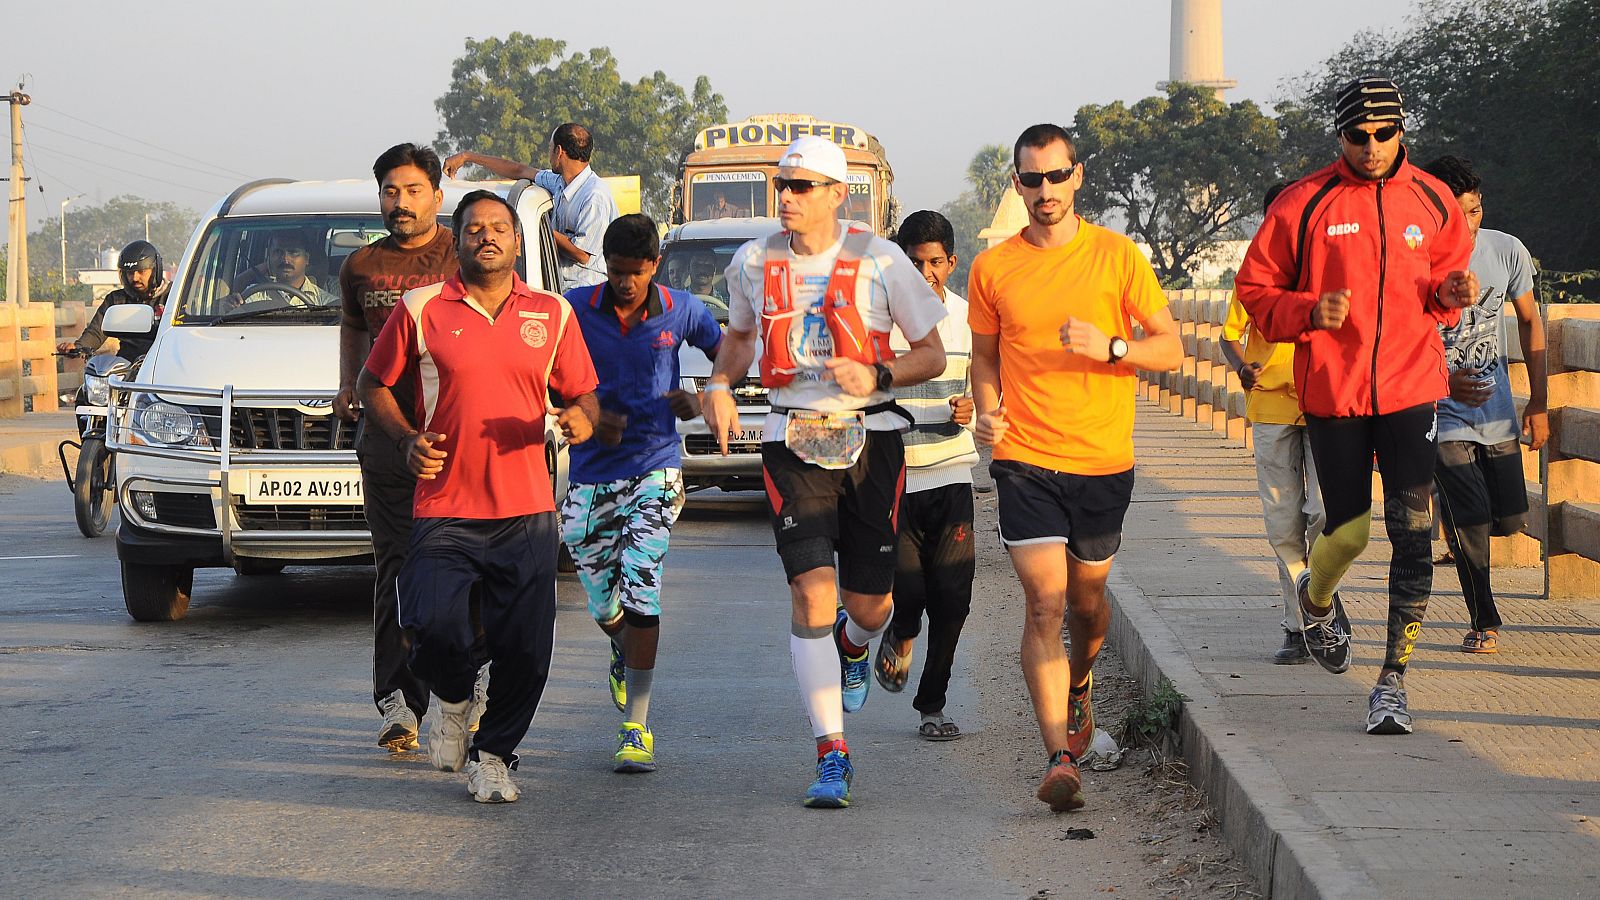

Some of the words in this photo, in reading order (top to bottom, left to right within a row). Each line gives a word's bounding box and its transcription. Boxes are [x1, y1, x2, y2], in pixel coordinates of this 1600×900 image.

[731, 172, 762, 181] CEMENT
[1327, 223, 1360, 236] GEDO
[364, 289, 411, 307] BRE
[259, 480, 302, 496] AP.02
